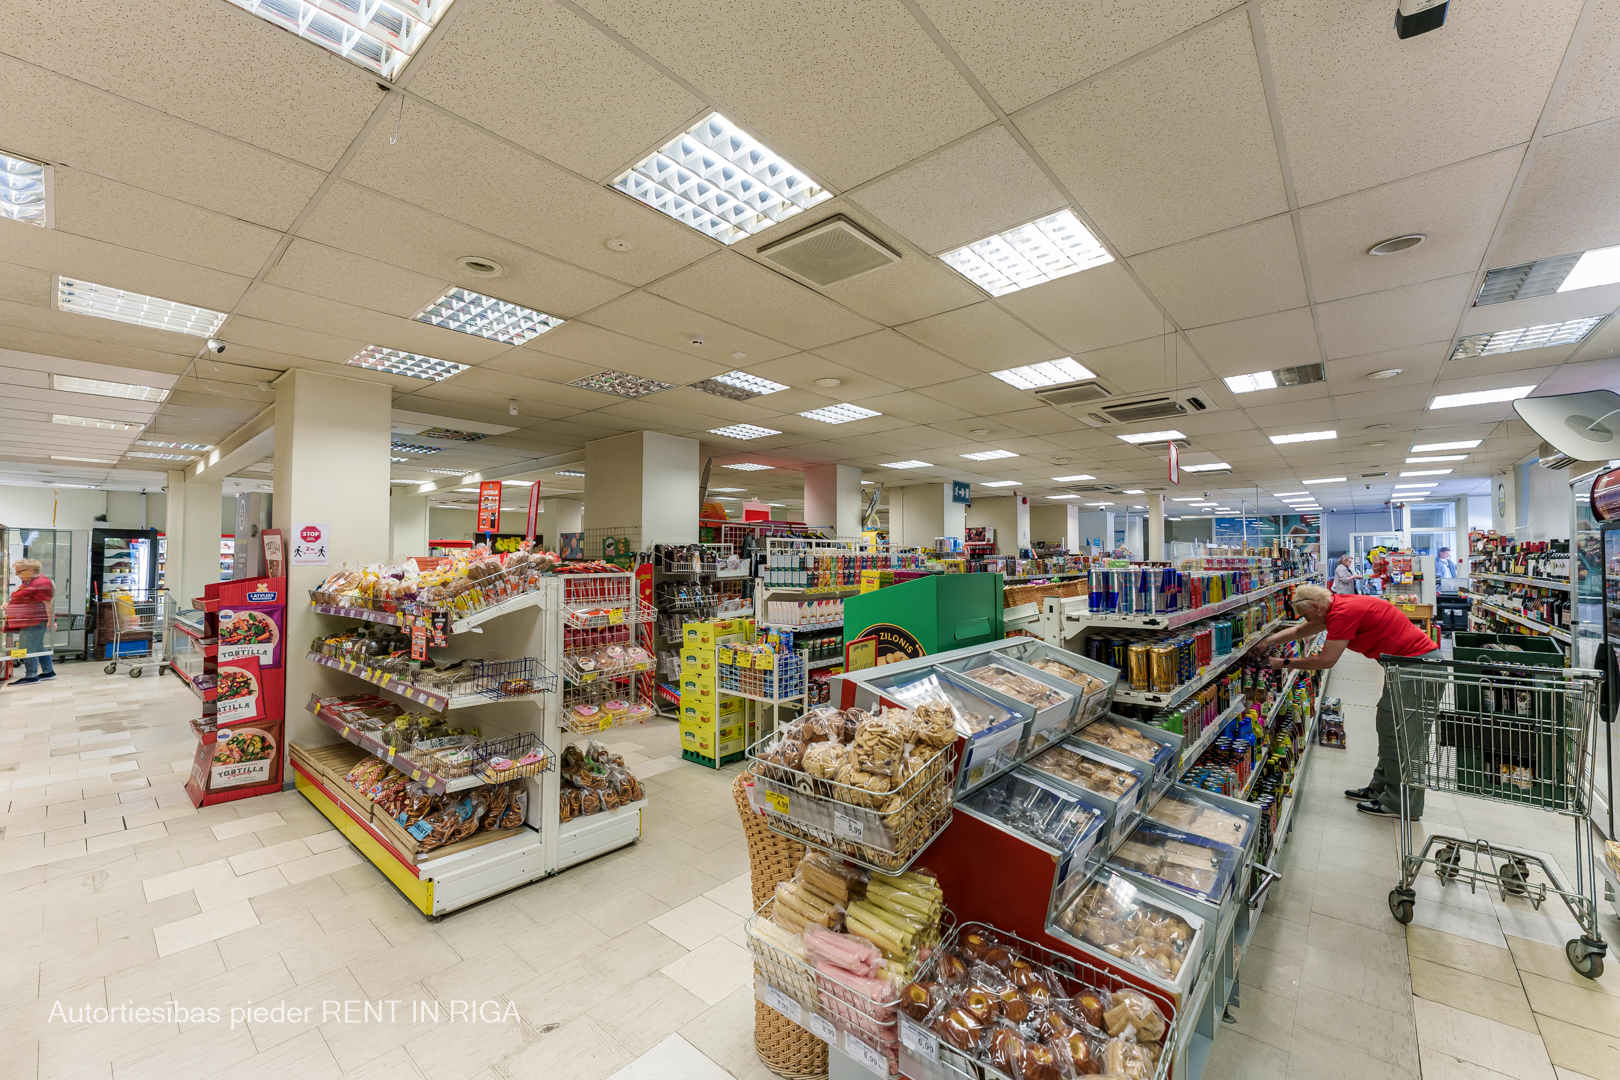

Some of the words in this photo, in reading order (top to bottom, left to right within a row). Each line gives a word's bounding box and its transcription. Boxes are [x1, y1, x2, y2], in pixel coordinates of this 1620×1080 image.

[879, 632, 914, 654] ZILONIS
[221, 649, 268, 658] TORTILLA
[217, 702, 250, 713] RTILLA
[217, 766, 264, 778] TORTILLA
[848, 824, 862, 836] 5,99
[917, 1038, 934, 1054] 6,99
[863, 1050, 878, 1066] 8,99
